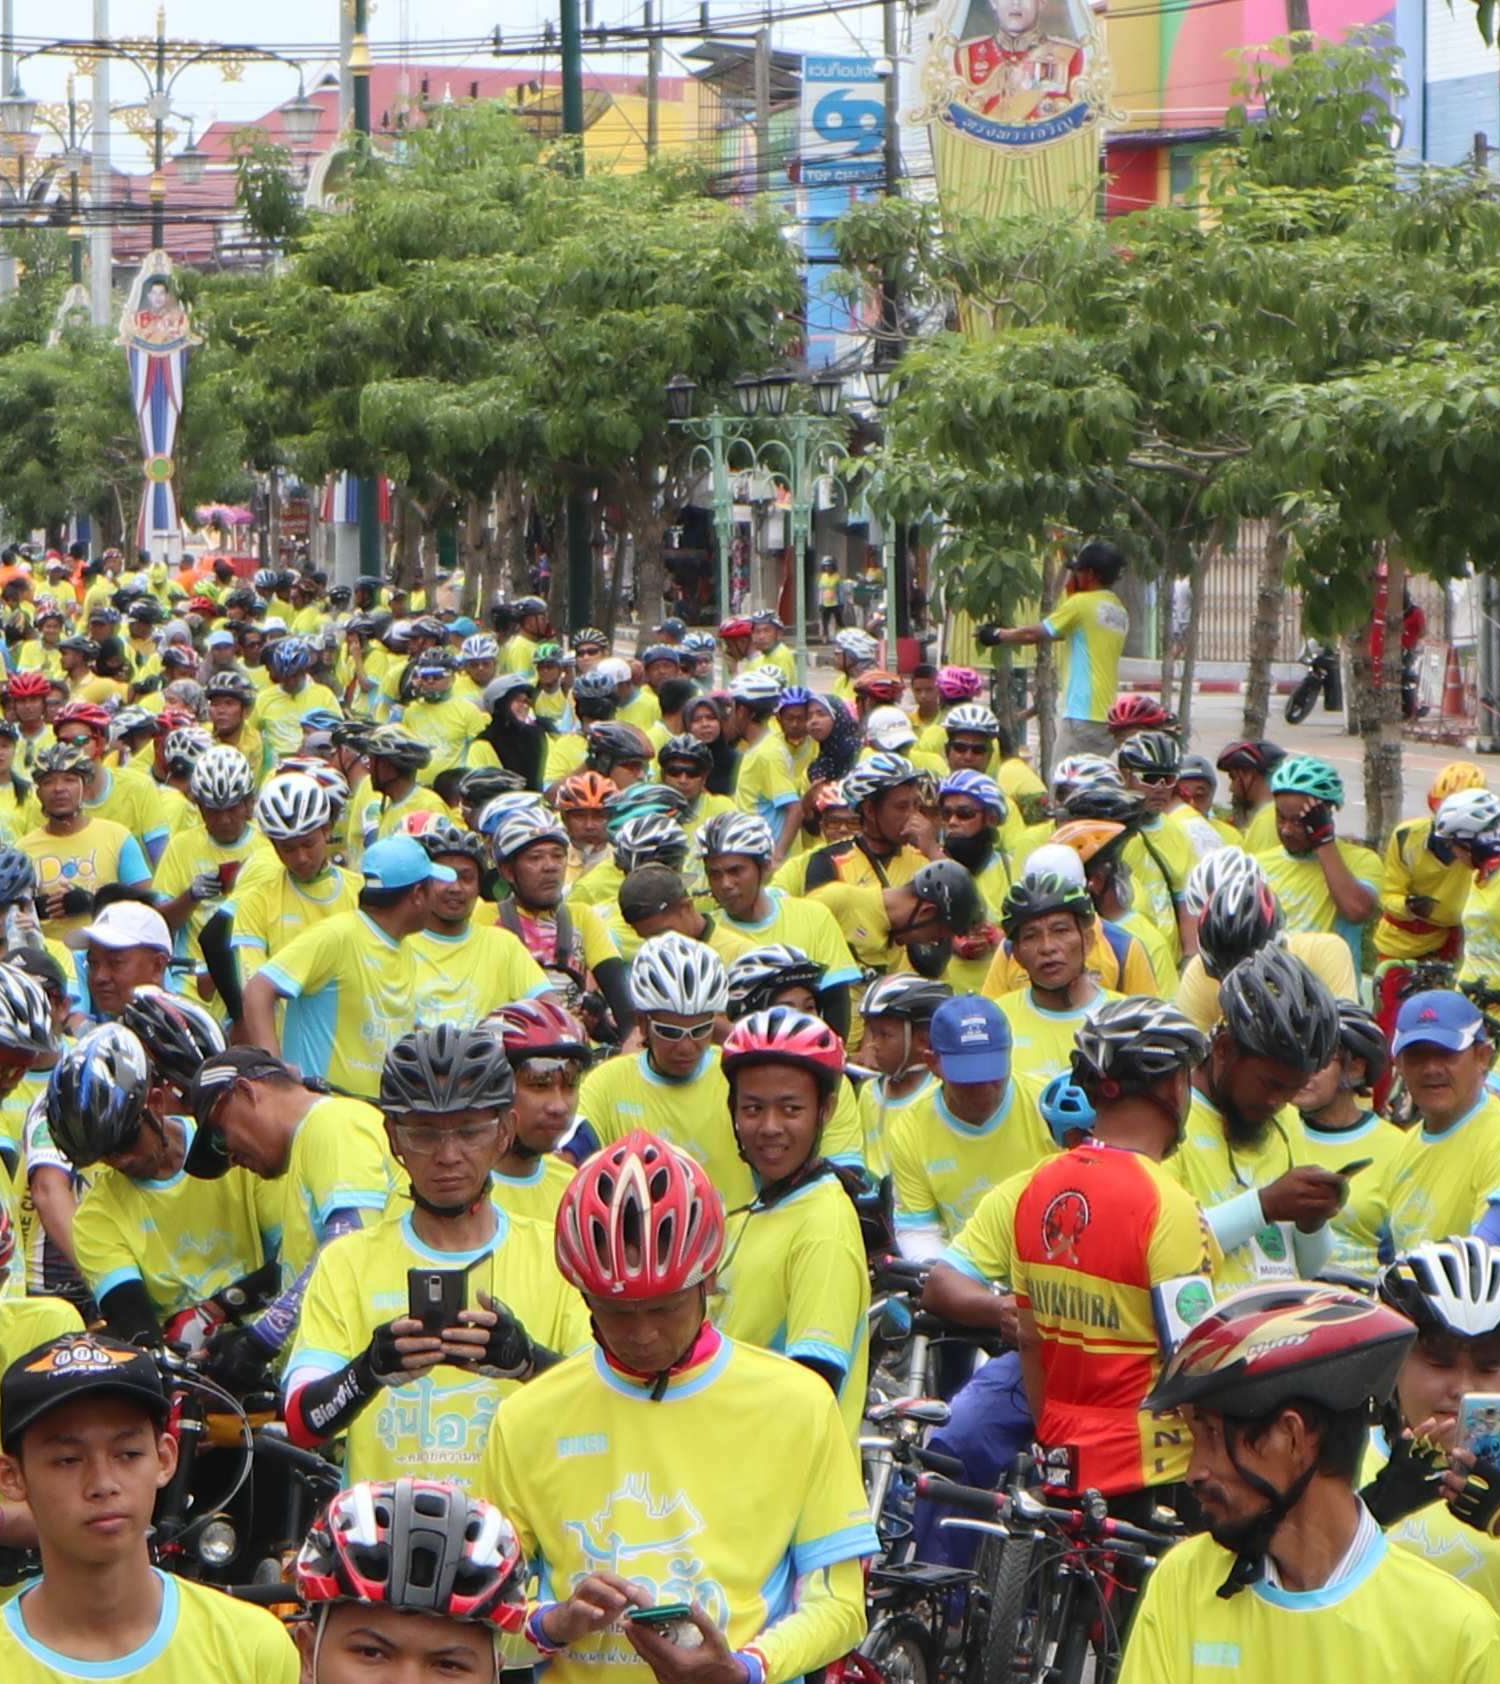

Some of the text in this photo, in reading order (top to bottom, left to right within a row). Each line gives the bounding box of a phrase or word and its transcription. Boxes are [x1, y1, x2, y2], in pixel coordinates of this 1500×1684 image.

[962, 115, 1074, 143] ทรงพระเจริญ
[806, 169, 831, 180] TOP
[1246, 1332, 1311, 1355] Huffy
